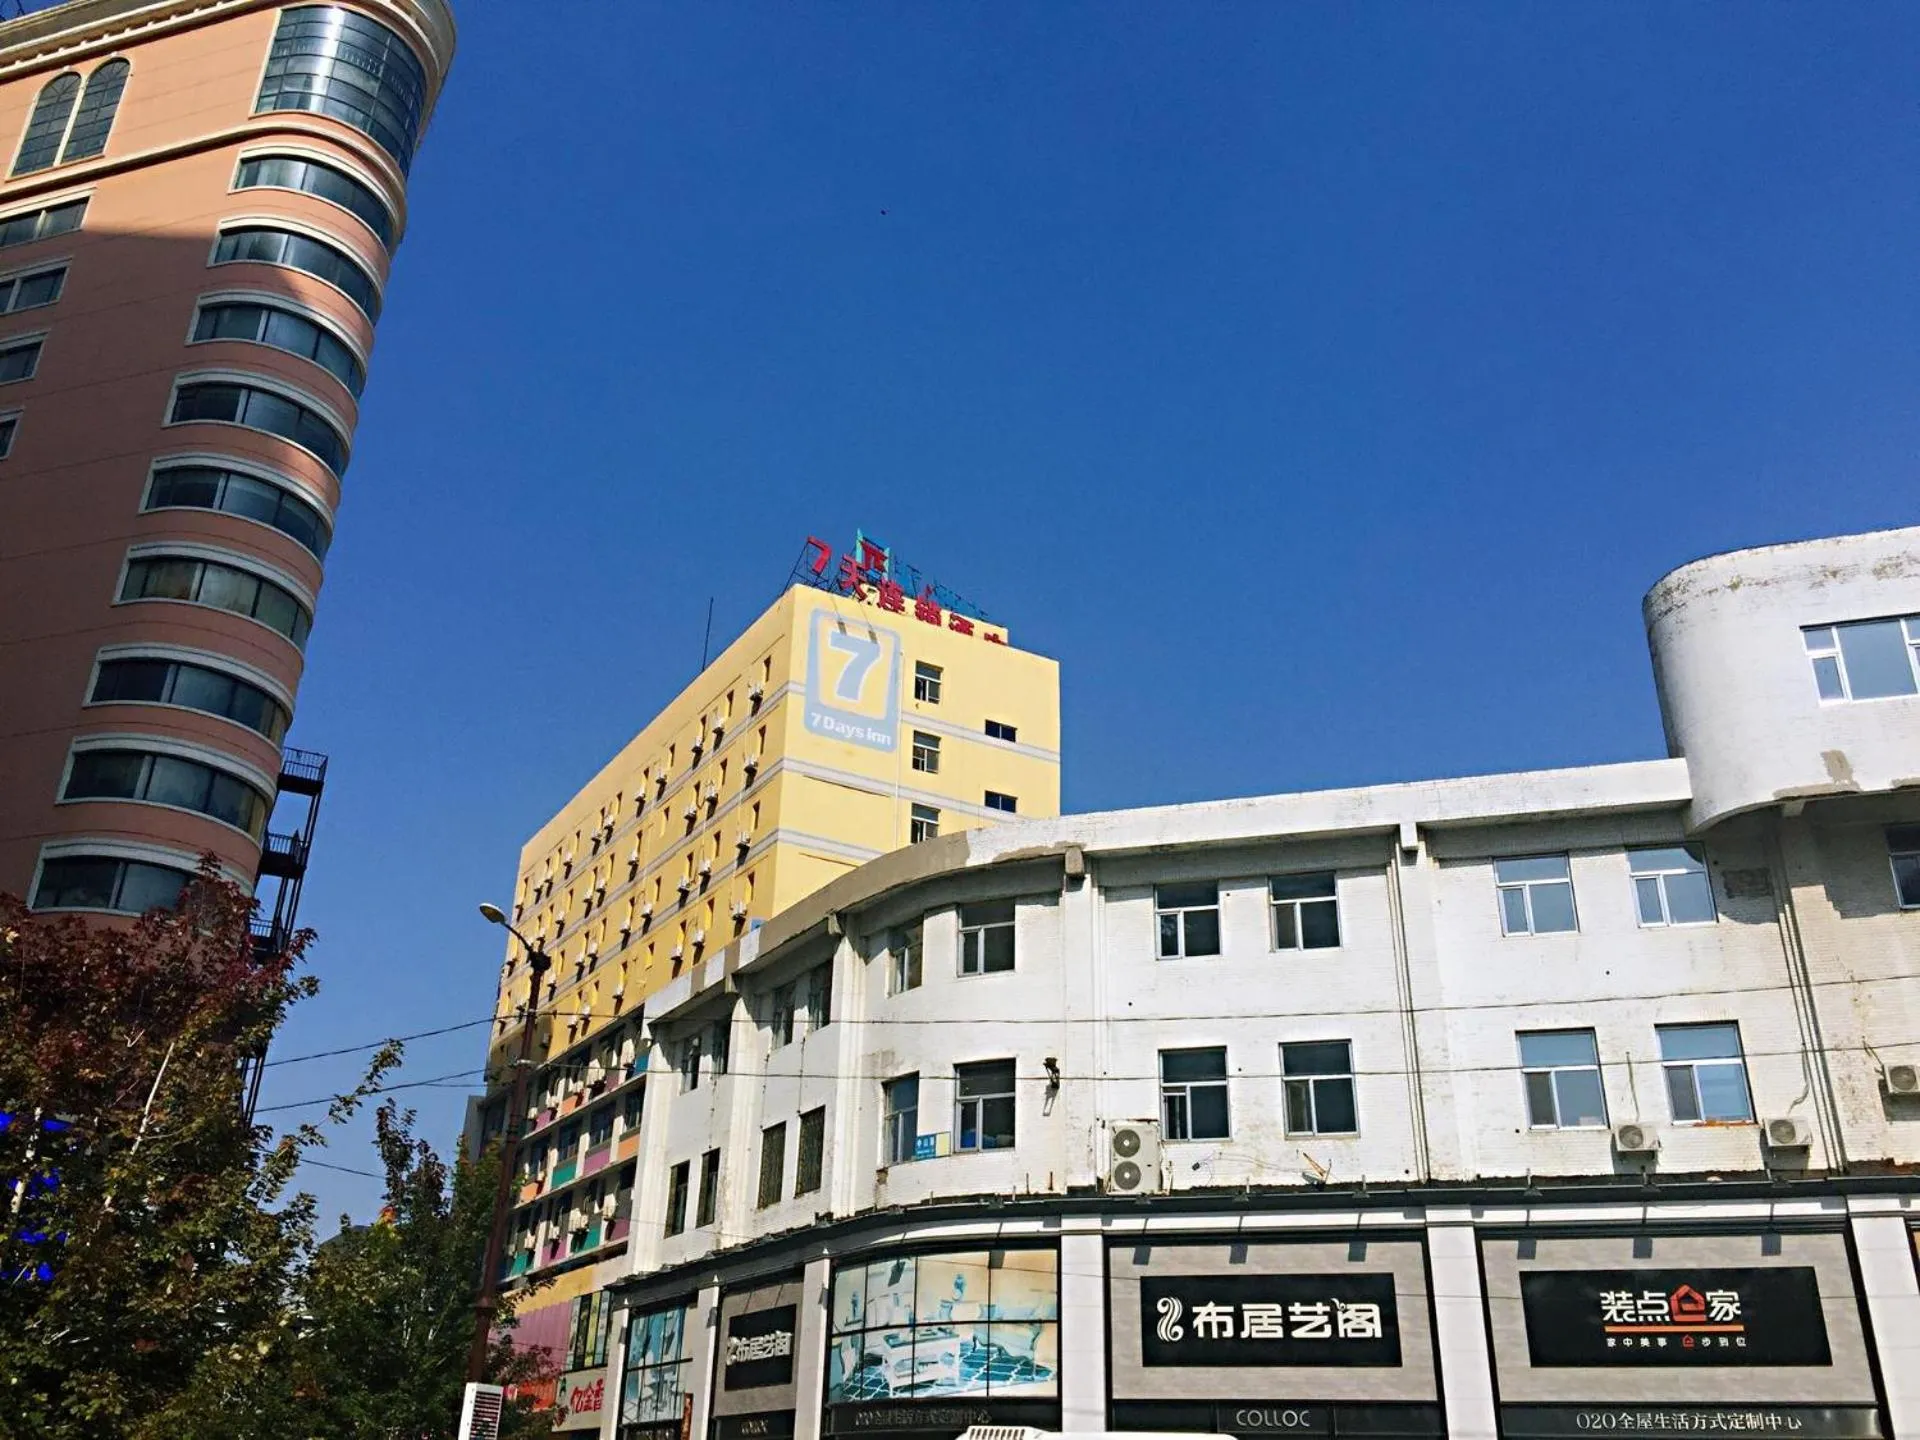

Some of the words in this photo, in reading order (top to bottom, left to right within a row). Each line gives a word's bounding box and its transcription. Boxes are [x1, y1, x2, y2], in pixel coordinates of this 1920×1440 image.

[829, 631, 882, 703] 7
[823, 716, 865, 738] Days
[1192, 1298, 1382, 1339] 布居艺阁
[1236, 1409, 1311, 1427] COLLOC
